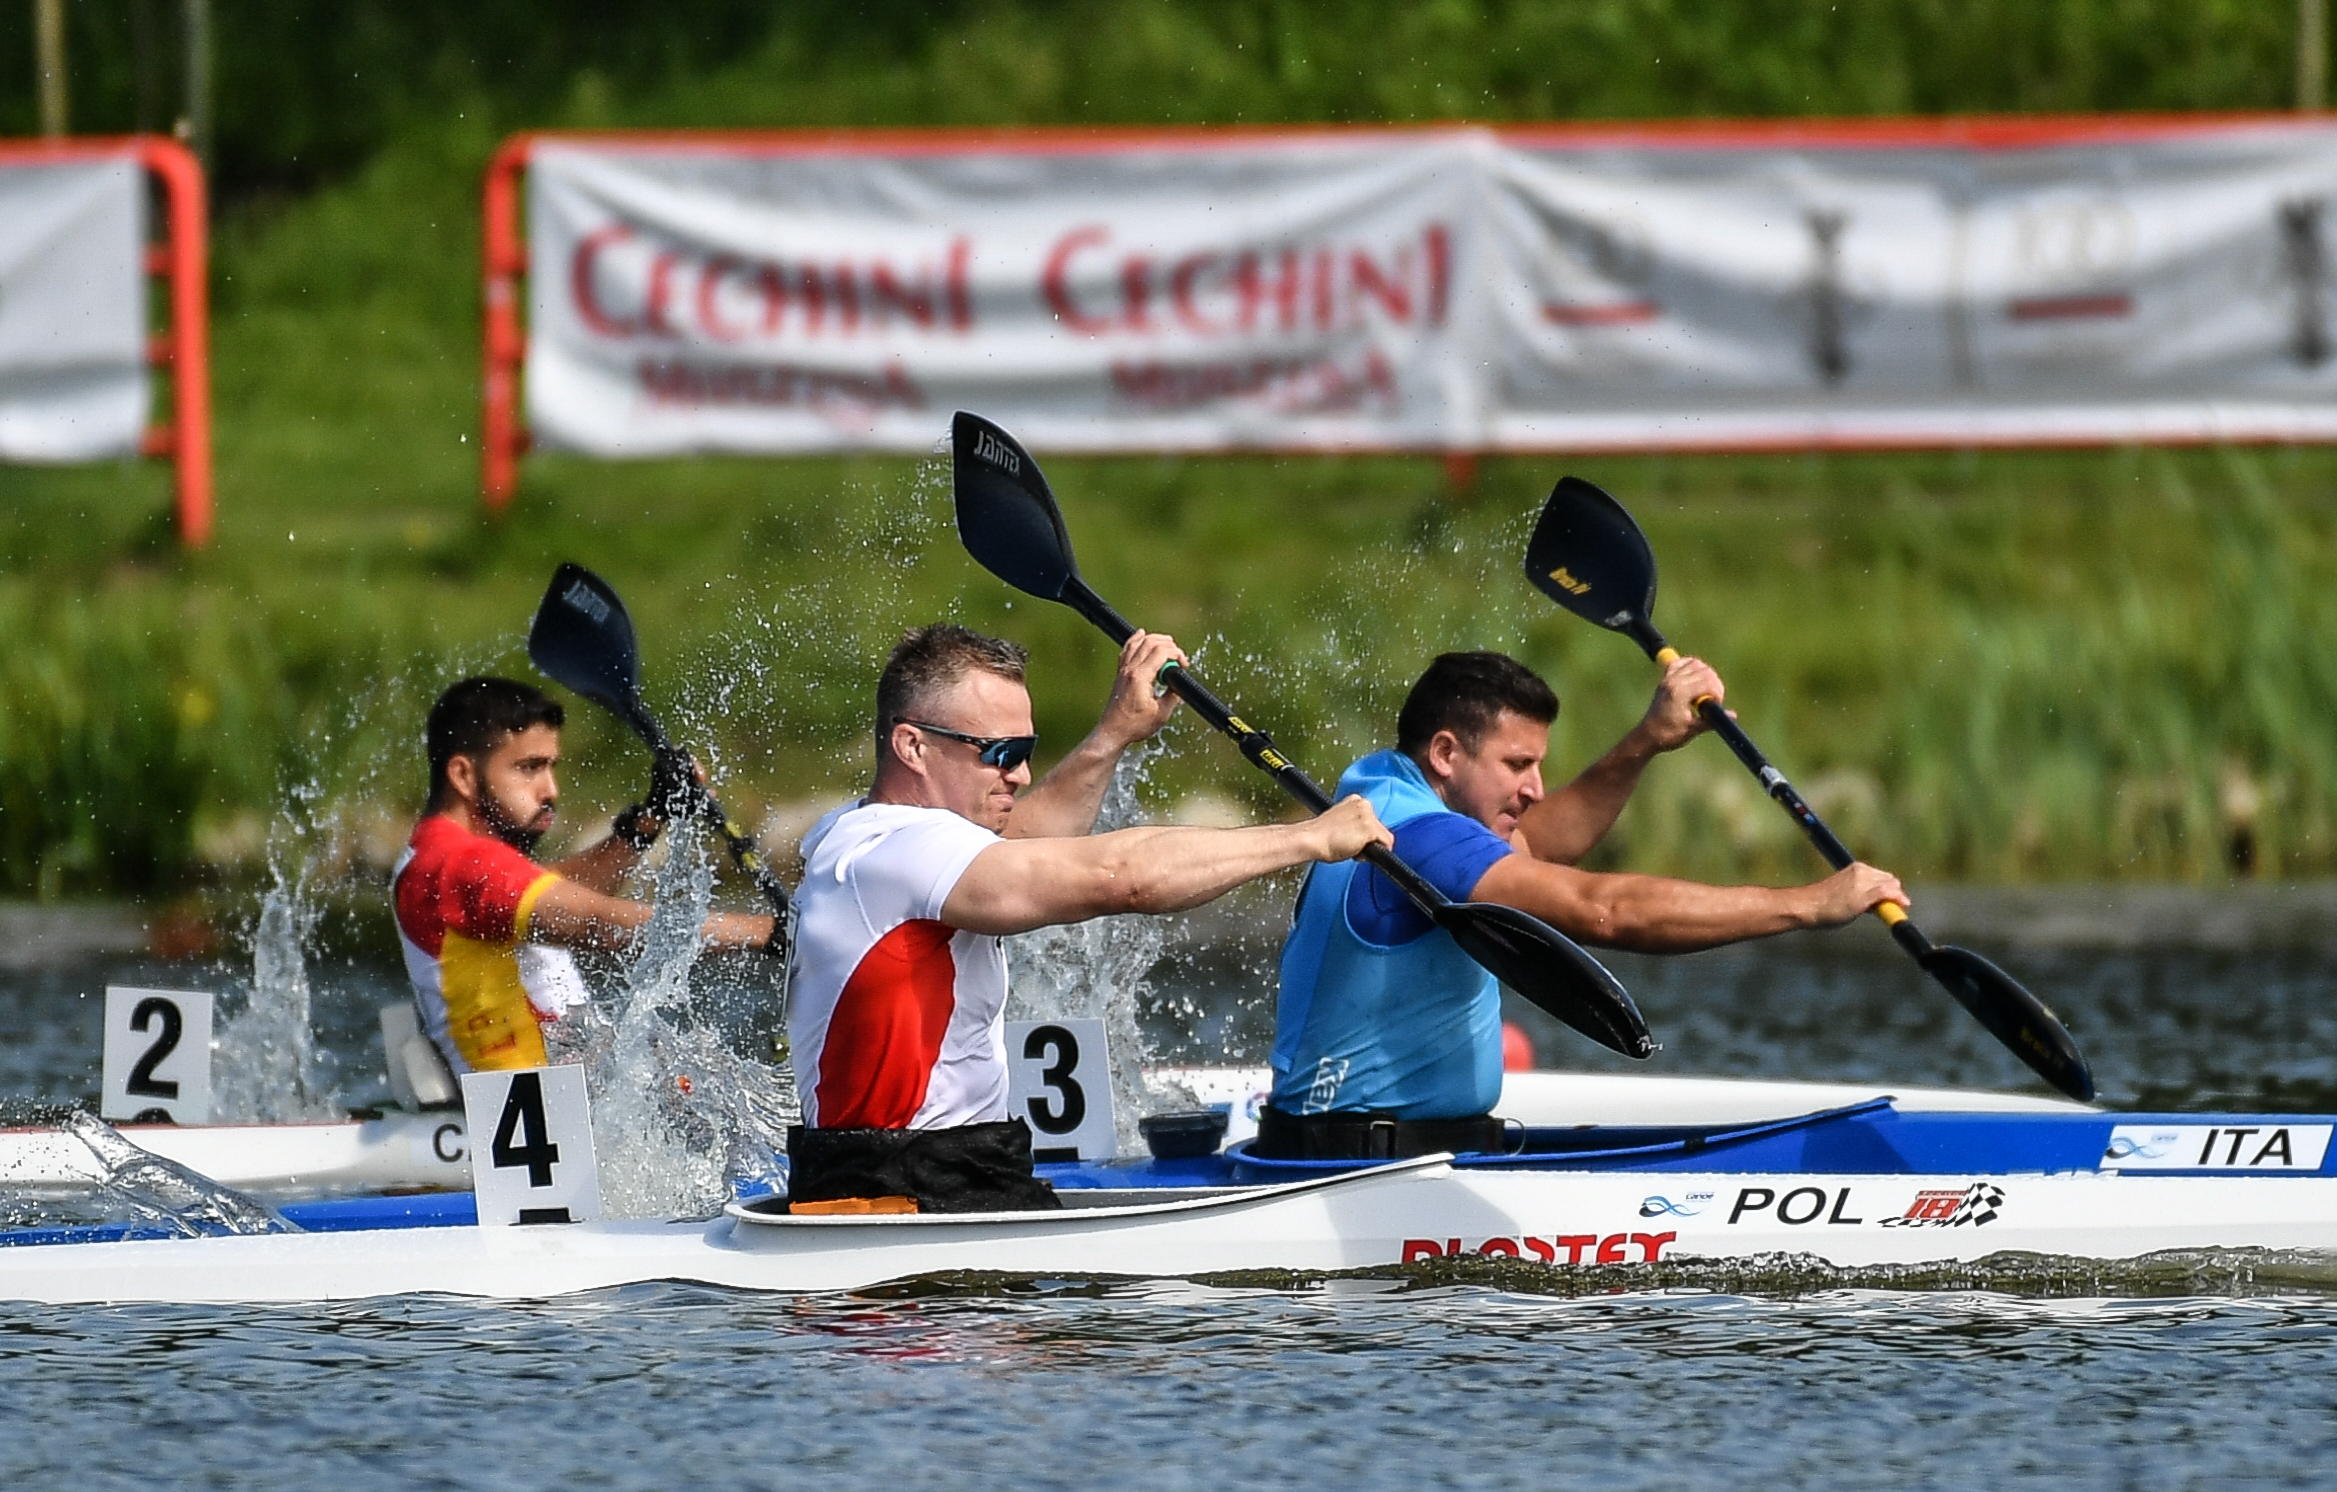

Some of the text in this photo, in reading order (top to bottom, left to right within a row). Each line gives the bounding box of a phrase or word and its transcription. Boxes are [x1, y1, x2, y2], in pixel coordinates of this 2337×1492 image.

[125, 996, 182, 1101] 2
[1022, 1024, 1087, 1135] 3
[433, 1123, 472, 1163] C
[491, 1072, 560, 1188] 4
[2198, 1128, 2293, 1166] ITA
[1727, 1186, 1863, 1226] POL
